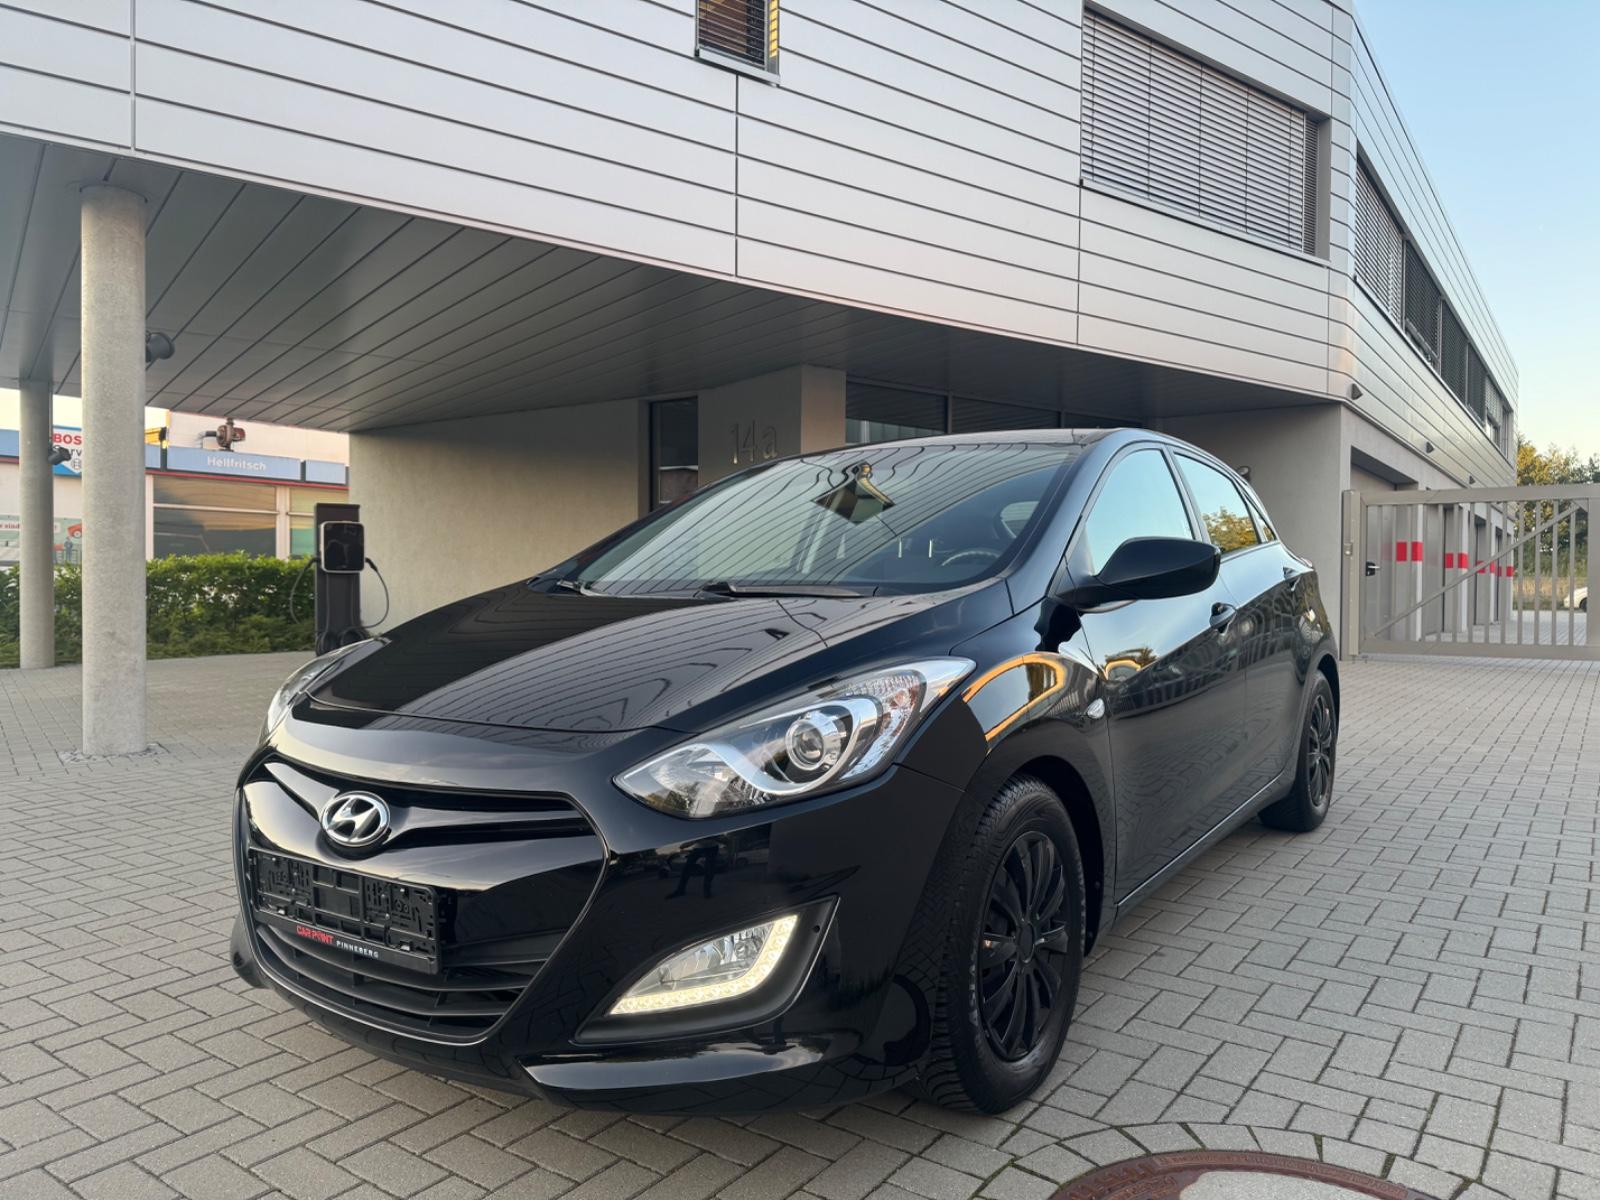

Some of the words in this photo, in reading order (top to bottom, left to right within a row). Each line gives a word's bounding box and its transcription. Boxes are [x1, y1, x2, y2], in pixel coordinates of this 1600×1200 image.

[730, 419, 777, 464] 14a
[207, 456, 267, 471] Hellfritsch
[336, 940, 379, 958] PINNEBERG
